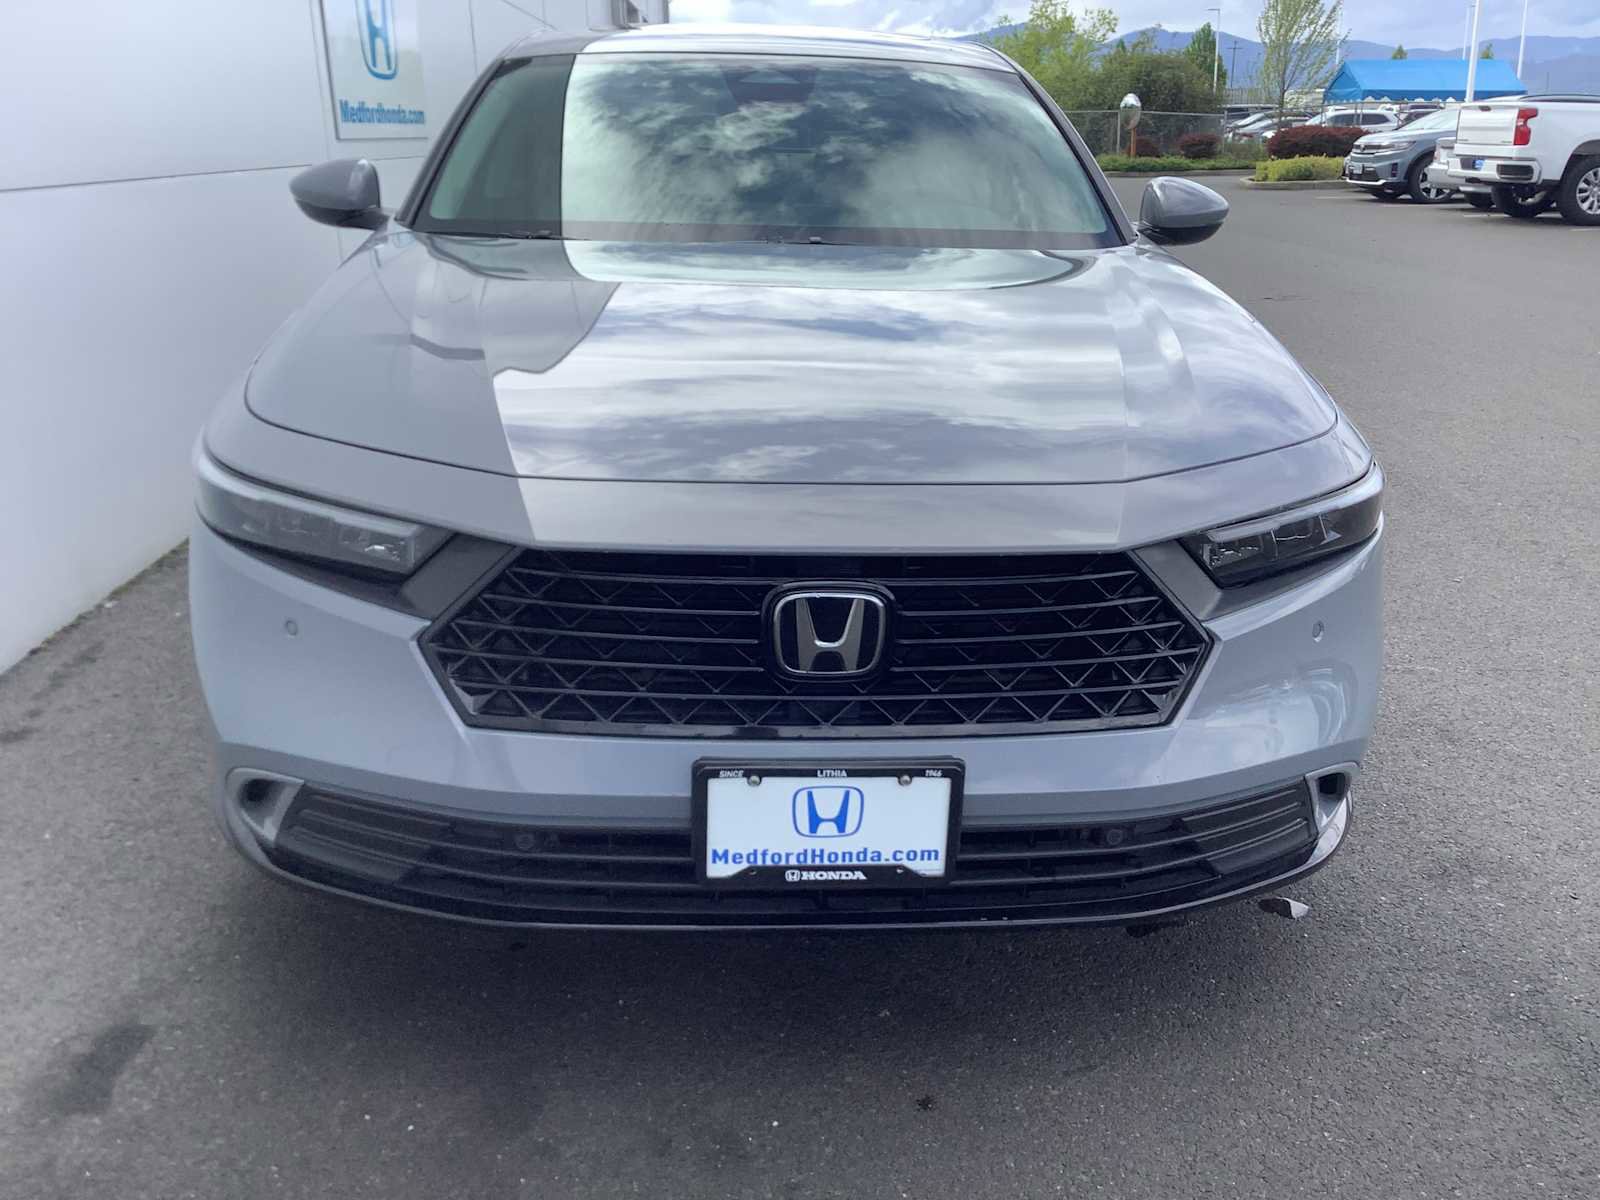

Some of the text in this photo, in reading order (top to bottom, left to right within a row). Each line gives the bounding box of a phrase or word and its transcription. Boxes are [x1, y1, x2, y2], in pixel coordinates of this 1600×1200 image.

[719, 769, 745, 778] SINCE
[816, 769, 848, 778] LITHIA
[710, 847, 940, 866] MedfordHonda.com
[800, 870, 868, 881] HONDA
